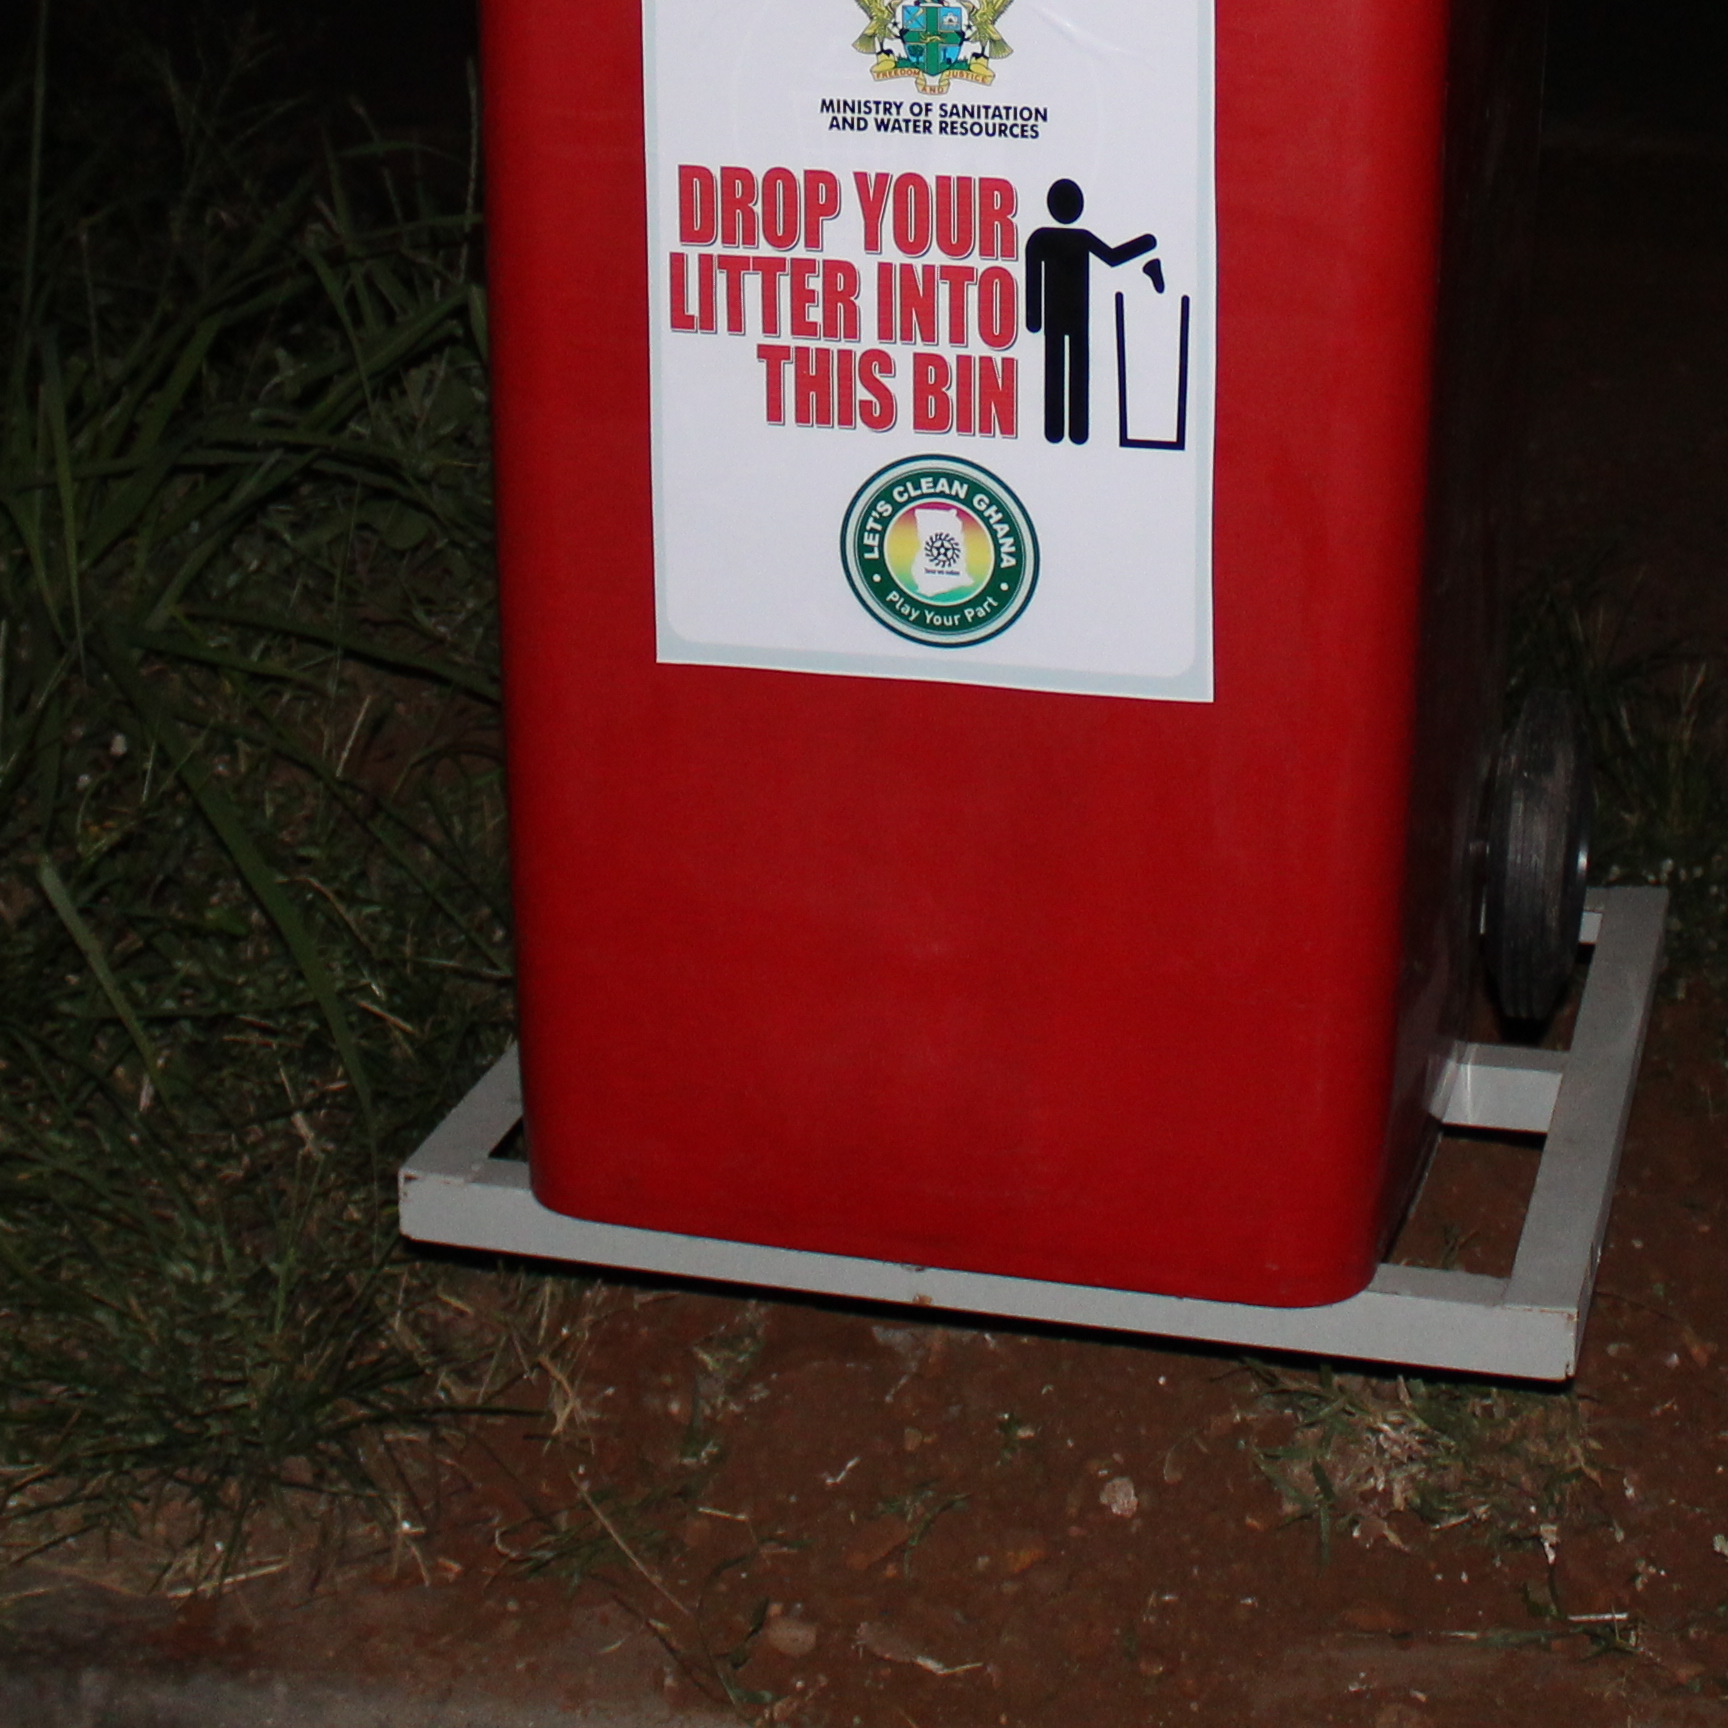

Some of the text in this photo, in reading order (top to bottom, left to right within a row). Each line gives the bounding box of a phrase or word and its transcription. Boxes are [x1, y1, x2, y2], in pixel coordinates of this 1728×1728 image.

[876, 67, 920, 80] FREEDOM
[945, 70, 987, 85] JUSTICE
[921, 85, 945, 94] AND
[819, 98, 1048, 122] MINISTRY OF SANITATION
[828, 116, 1040, 140] AND WATER RESOURCES
[677, 164, 1019, 262] DROP YOUR
[669, 251, 1019, 351] LITTER INTO
[756, 343, 1018, 440] THIS BIN
[863, 476, 1017, 569] LET'S CLEAN GHANA
[885, 590, 999, 626] Play Your Part
